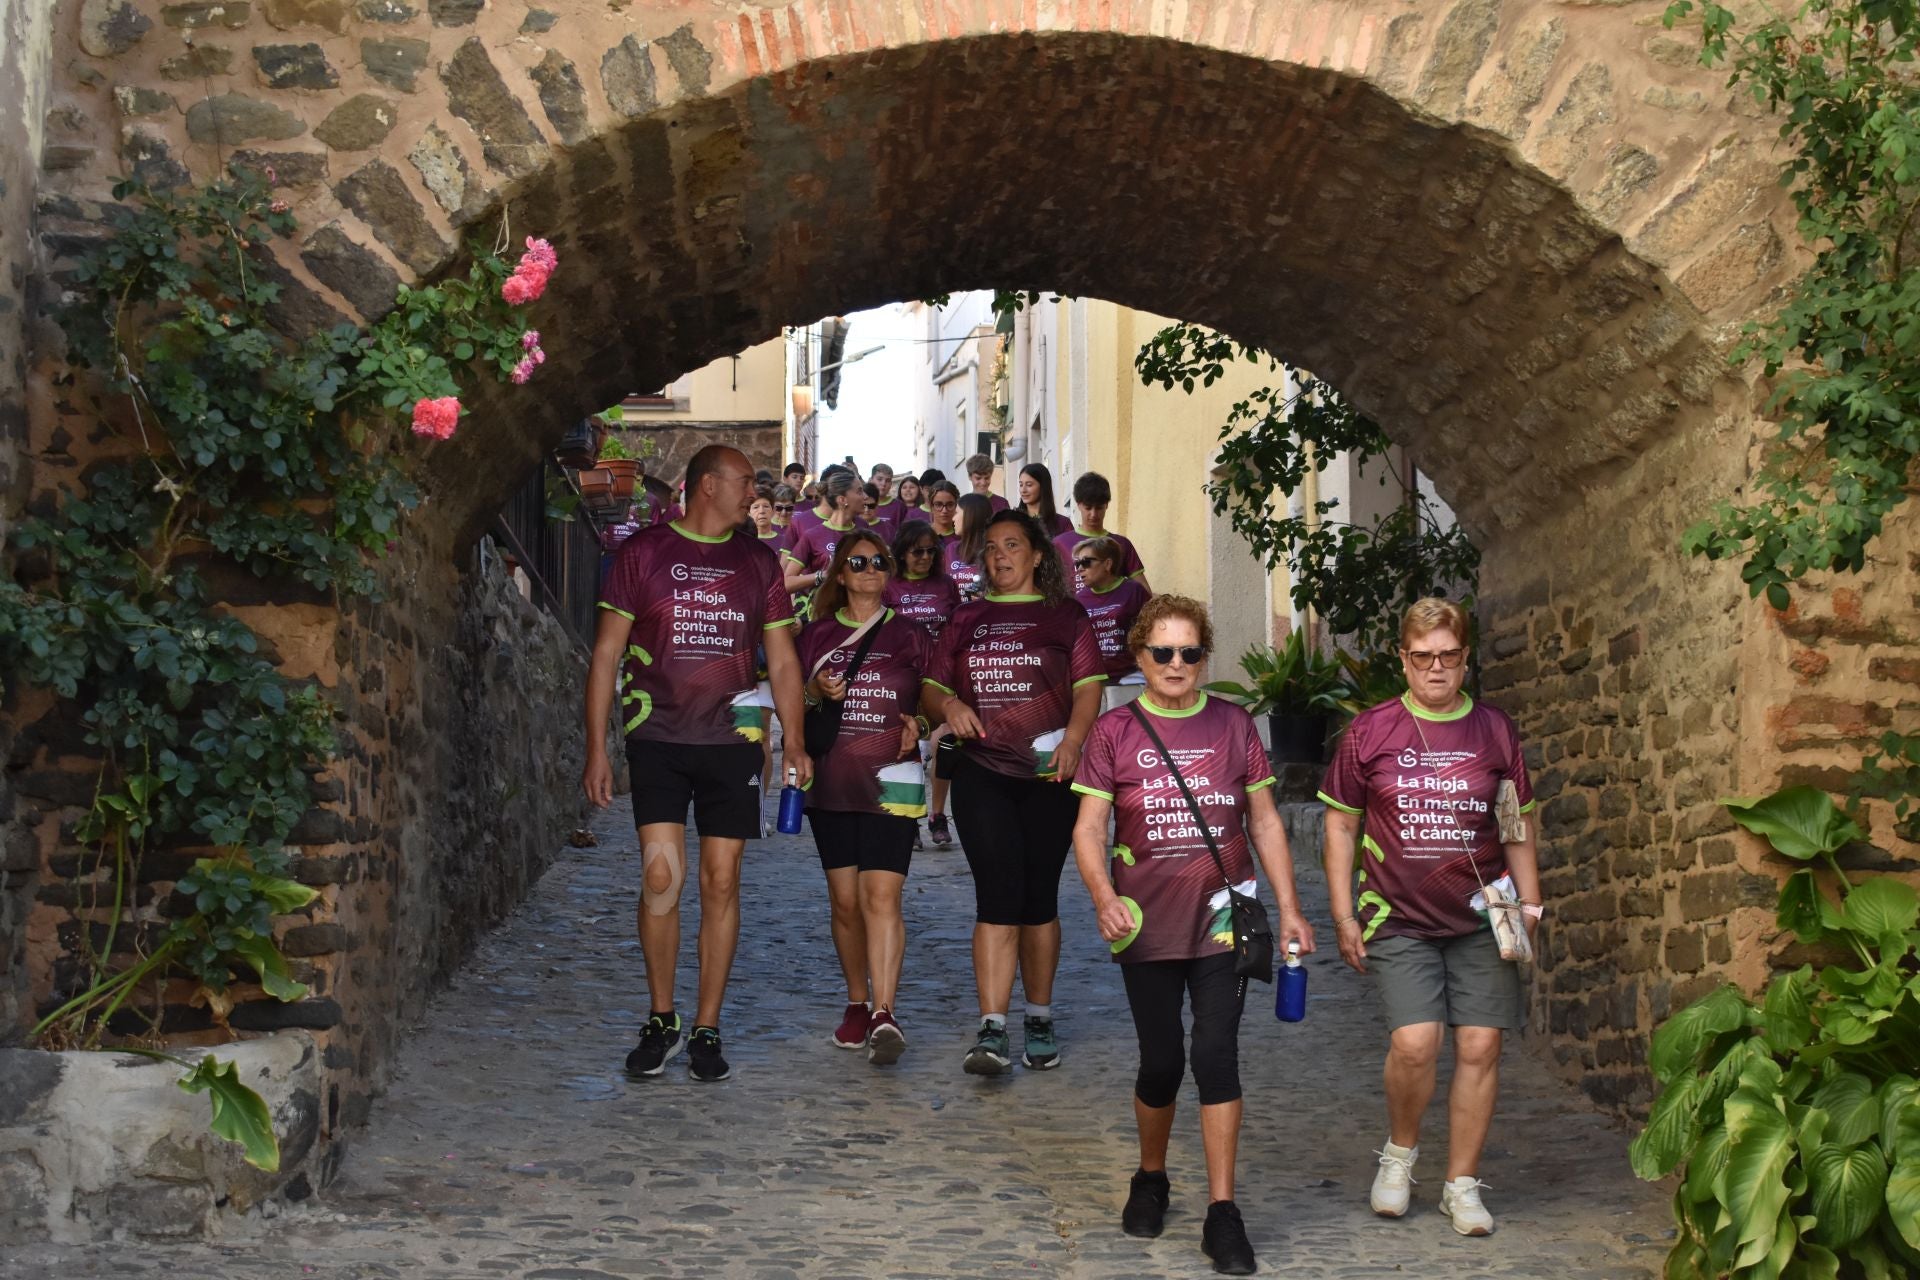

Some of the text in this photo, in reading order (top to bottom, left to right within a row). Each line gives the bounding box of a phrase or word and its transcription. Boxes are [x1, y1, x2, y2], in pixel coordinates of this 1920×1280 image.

[674, 588, 726, 605] La Rioja
[674, 605, 745, 622] En marcha
[673, 621, 717, 633] contra
[1096, 619, 1116, 628] Rioja
[673, 632, 734, 647] el cáncer
[970, 641, 1024, 652] La Rioja
[968, 654, 1041, 667] En marcha
[851, 670, 880, 683] ioja
[970, 668, 1012, 680] contra
[848, 687, 896, 699] marcha
[985, 681, 1032, 693] cáncer
[843, 699, 869, 709] ntra
[841, 710, 886, 723] cáncer
[1143, 775, 1210, 789] La Roja
[1397, 775, 1468, 793] La Rioja
[1144, 792, 1235, 809] En mrcha
[1397, 795, 1487, 812] En marcha
[1399, 812, 1454, 824] contra
[1147, 826, 1164, 840] el
[1400, 826, 1476, 840] el cáncer
